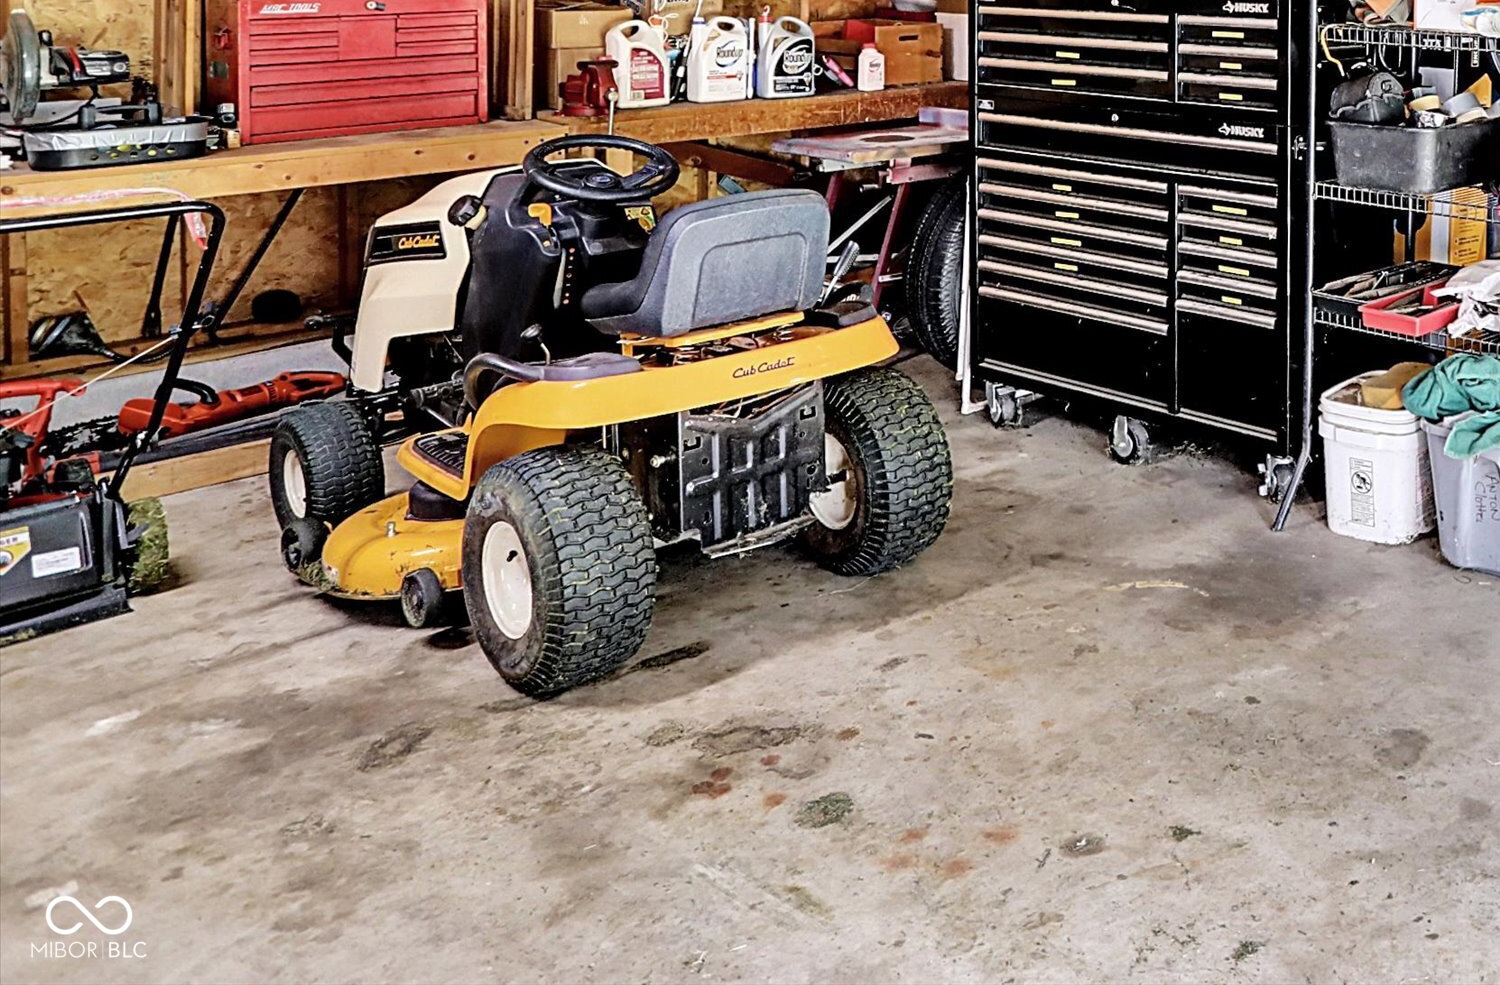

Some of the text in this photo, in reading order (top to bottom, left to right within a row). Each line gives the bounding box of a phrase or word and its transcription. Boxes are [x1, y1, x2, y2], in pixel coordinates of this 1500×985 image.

[1234, 2, 1269, 14] HUSKY
[1230, 124, 1265, 138] HUSKY
[413, 234, 440, 248] Cadet
[732, 356, 796, 379] Cub Cadet
